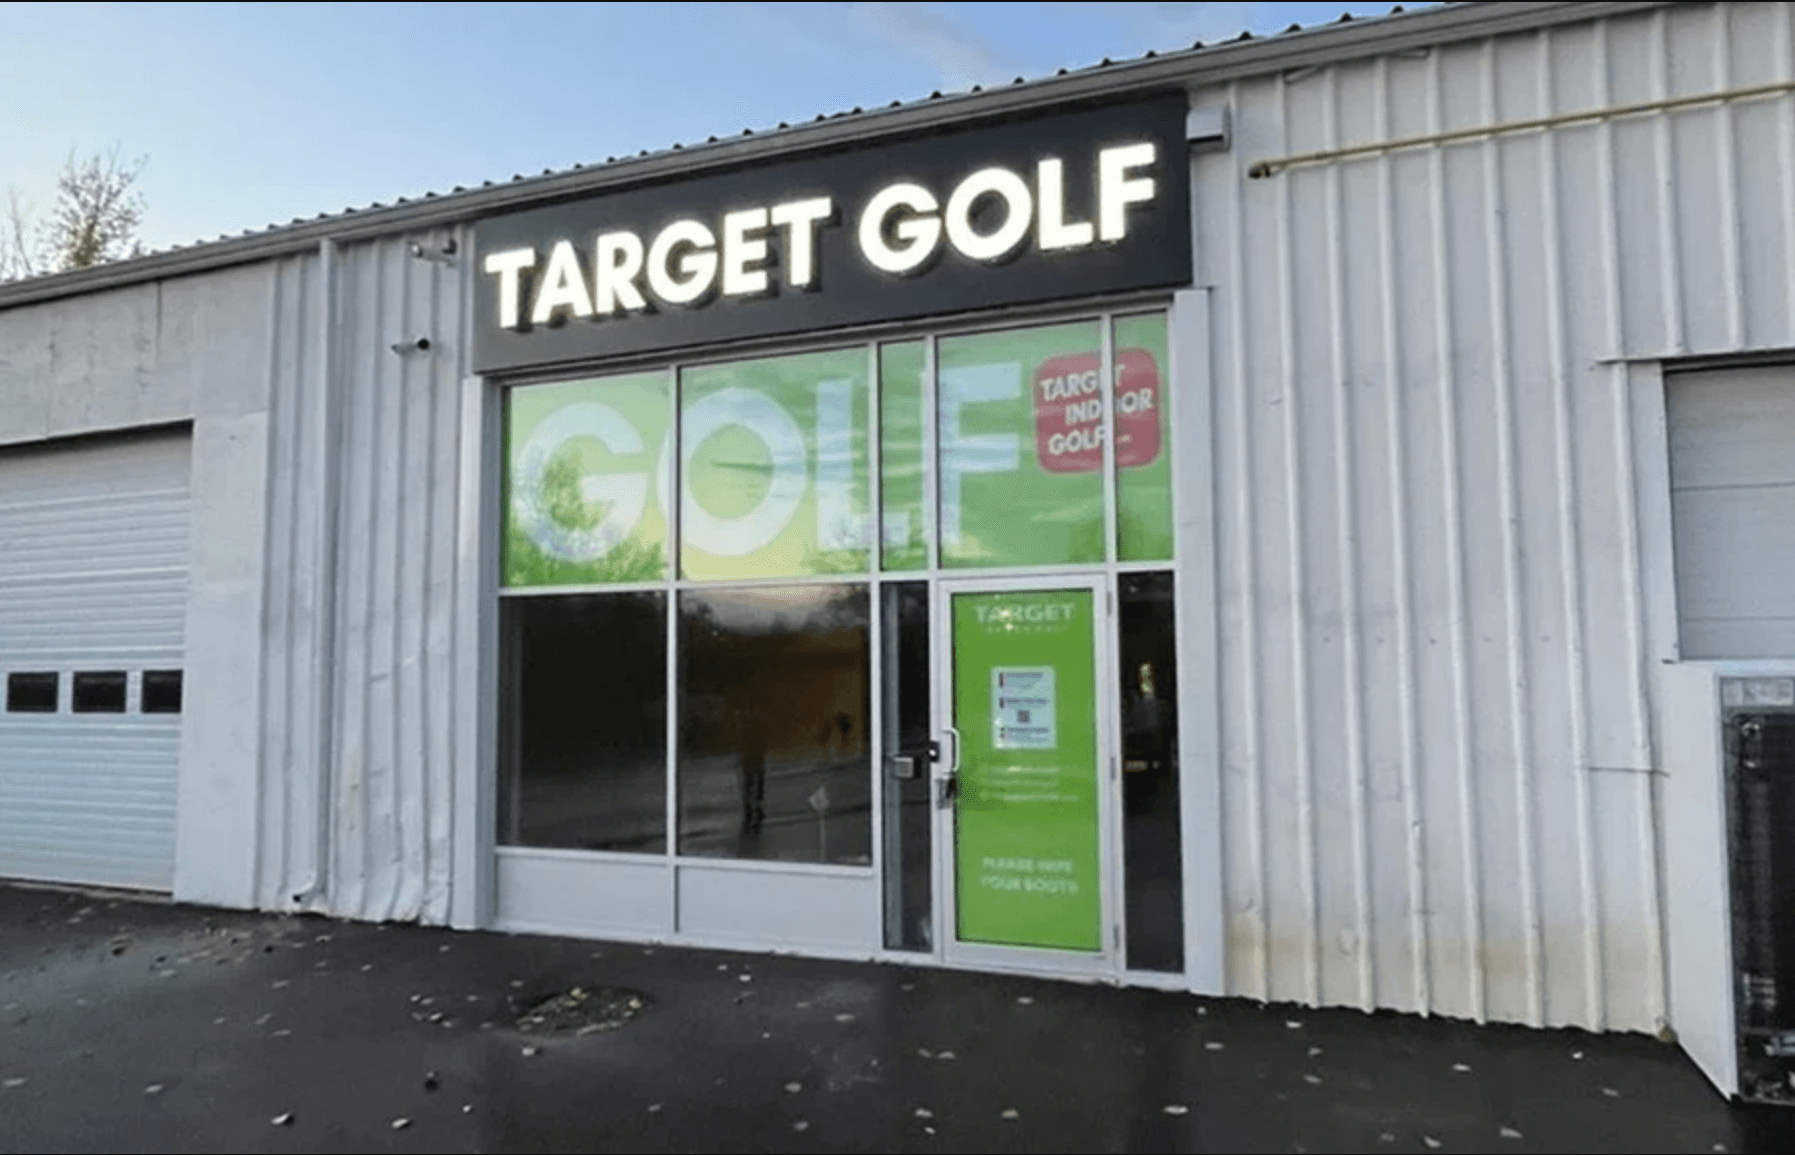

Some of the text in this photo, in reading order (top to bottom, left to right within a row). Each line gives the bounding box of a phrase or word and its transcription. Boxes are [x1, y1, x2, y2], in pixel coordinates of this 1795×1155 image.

[485, 143, 1157, 329] TARGET GOLF
[1040, 363, 1126, 401] TARGT
[1064, 388, 1153, 426] INDOR
[512, 360, 1021, 563] GOLF
[974, 602, 1075, 623] TARGET
